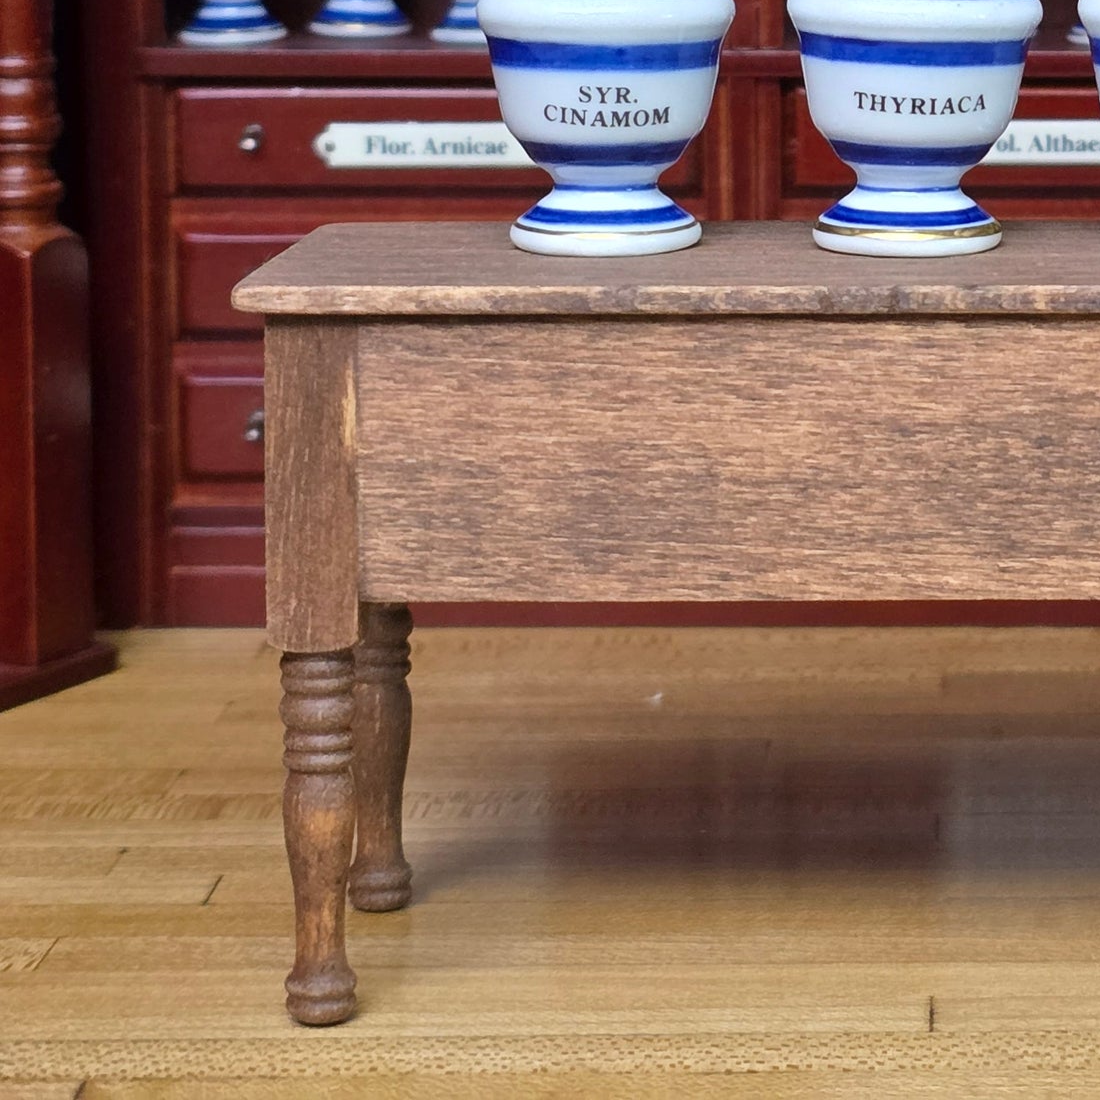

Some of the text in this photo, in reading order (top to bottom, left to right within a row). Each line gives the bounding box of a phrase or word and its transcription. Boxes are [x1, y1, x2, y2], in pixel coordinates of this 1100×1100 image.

[577, 85, 639, 104] SYR.
[853, 90, 987, 117] THYRIACA
[543, 103, 672, 128] CINAMOM
[364, 134, 508, 157] Flor. Arnicae
